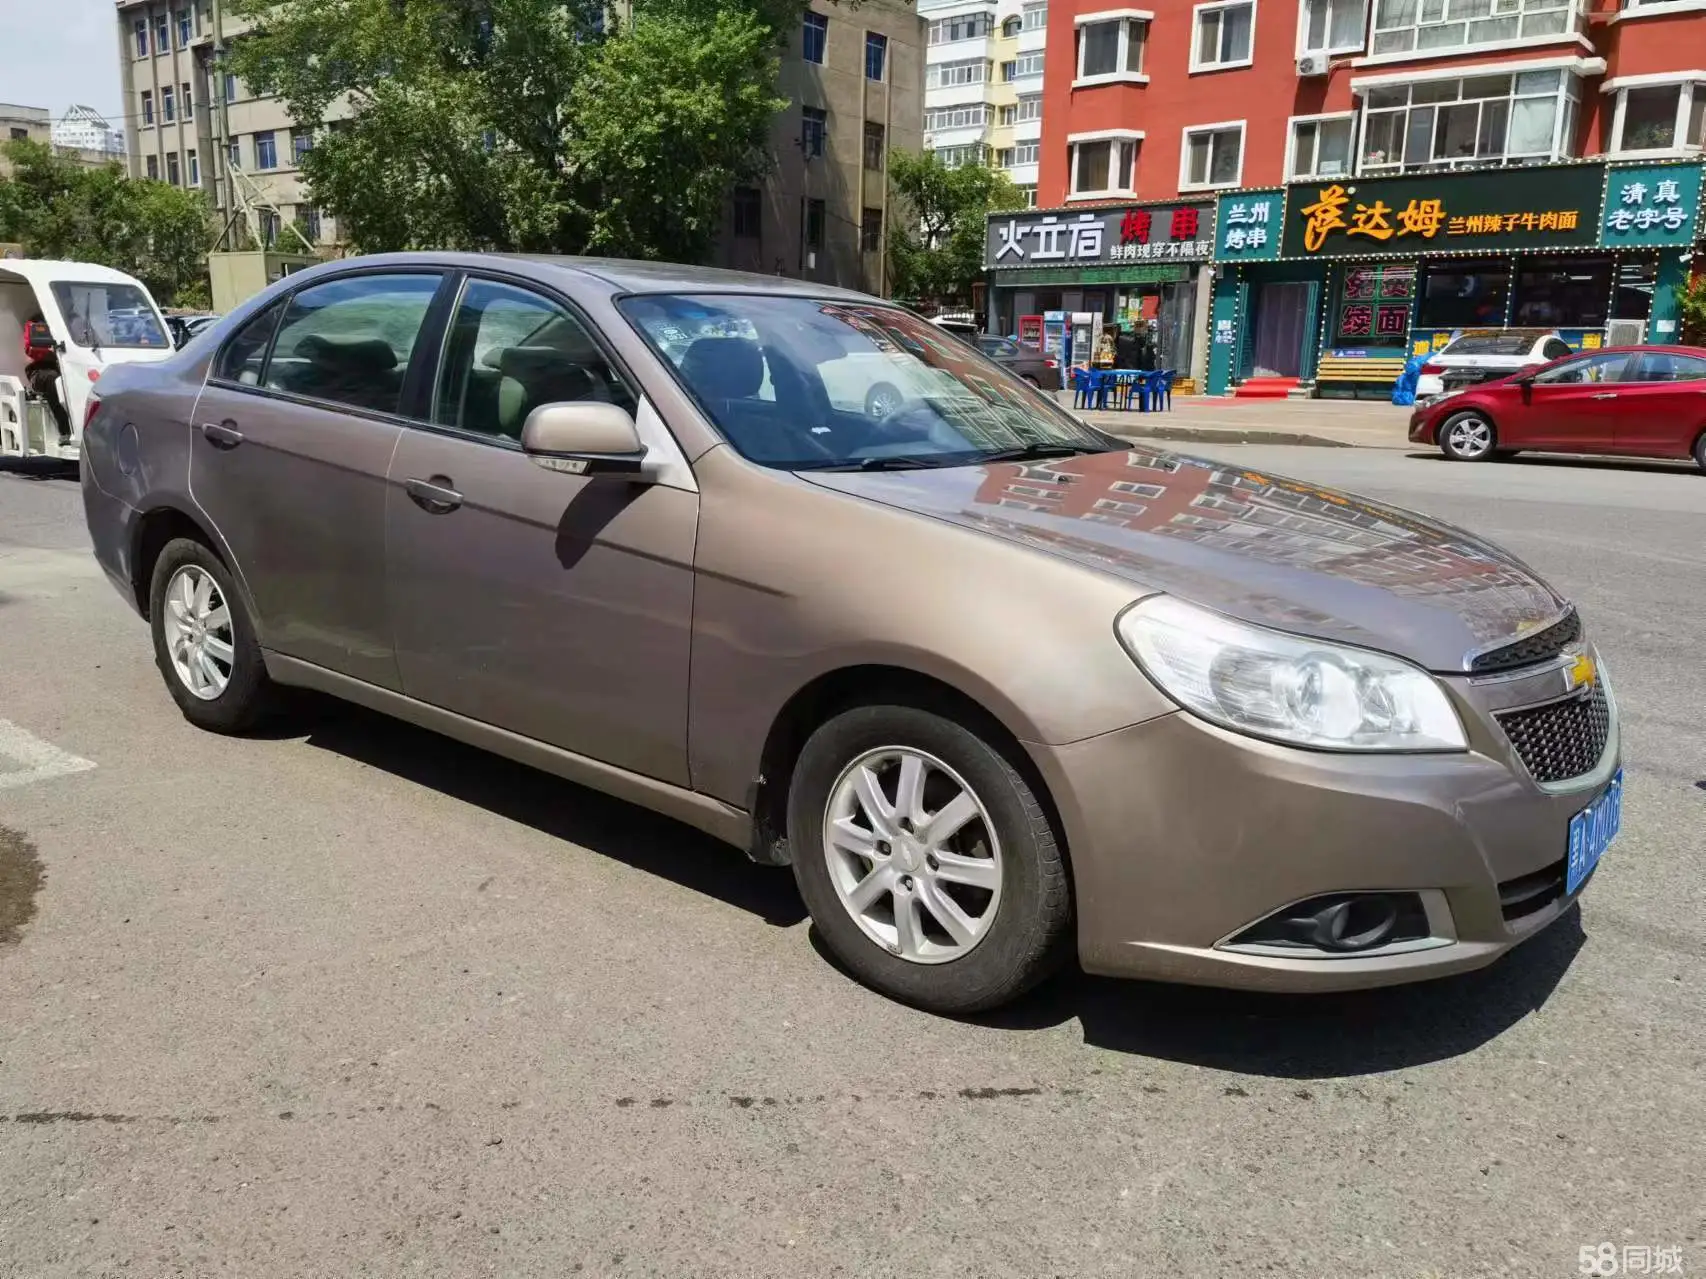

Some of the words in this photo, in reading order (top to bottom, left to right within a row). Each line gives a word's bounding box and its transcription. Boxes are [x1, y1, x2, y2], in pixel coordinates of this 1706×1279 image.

[1620, 179, 1681, 204] 清真
[1119, 205, 1199, 244] 烤串
[1226, 201, 1270, 224] 兰州
[1300, 184, 1447, 251] 萨达姆
[1447, 210, 1579, 234] 兰州辣子牛肉面
[1607, 207, 1689, 230] 老字号
[1110, 239, 1210, 259] 鲜肉现穿不隔夜
[1224, 227, 1268, 249] 烤串
[1341, 304, 1409, 335] 续面
